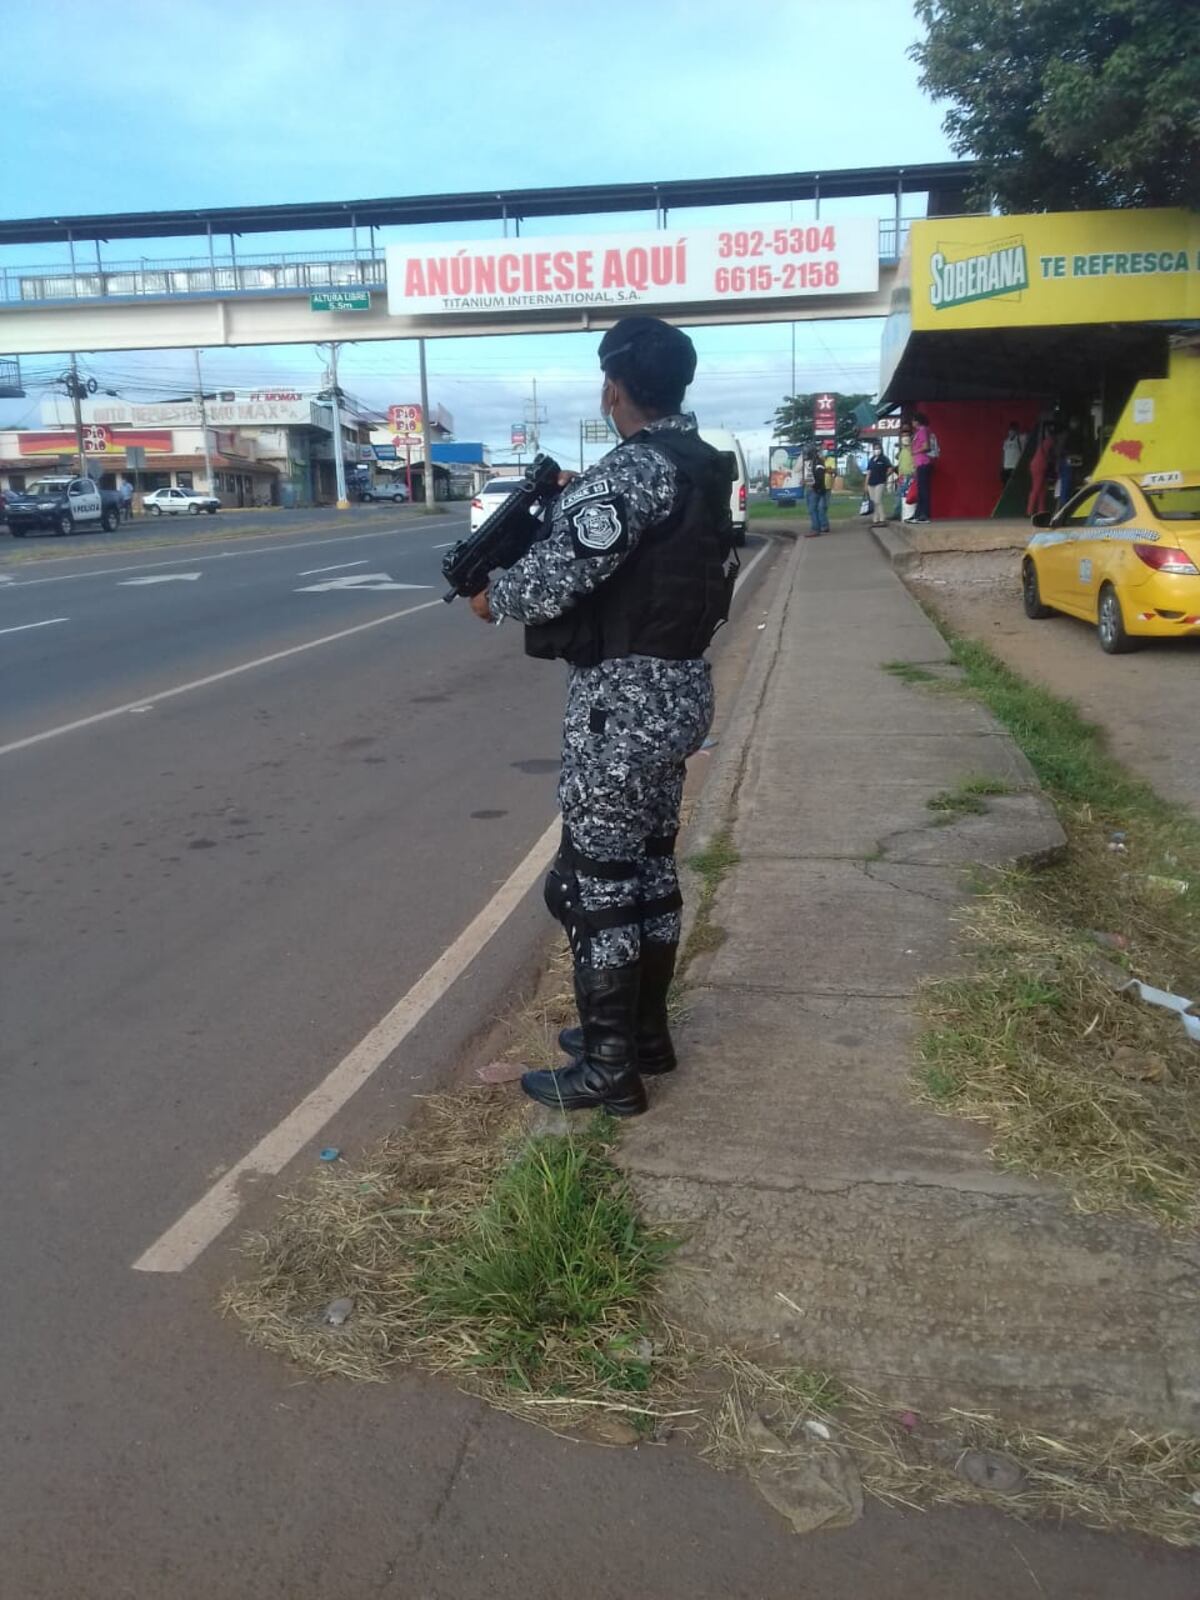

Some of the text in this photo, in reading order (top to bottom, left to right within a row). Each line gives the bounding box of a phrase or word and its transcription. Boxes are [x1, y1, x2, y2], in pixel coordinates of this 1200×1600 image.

[718, 225, 836, 258] 392-5304
[404, 237, 688, 297] ANÚNCIESE AQUÍ
[715, 260, 839, 293] 6615-2158
[1039, 250, 1190, 278] TE REFRESCA
[313, 291, 367, 303] ALTURA LIBRE
[442, 297, 505, 309] TITANIUM
[617, 289, 642, 302] S.A.
[1150, 473, 1179, 483] TAXI
